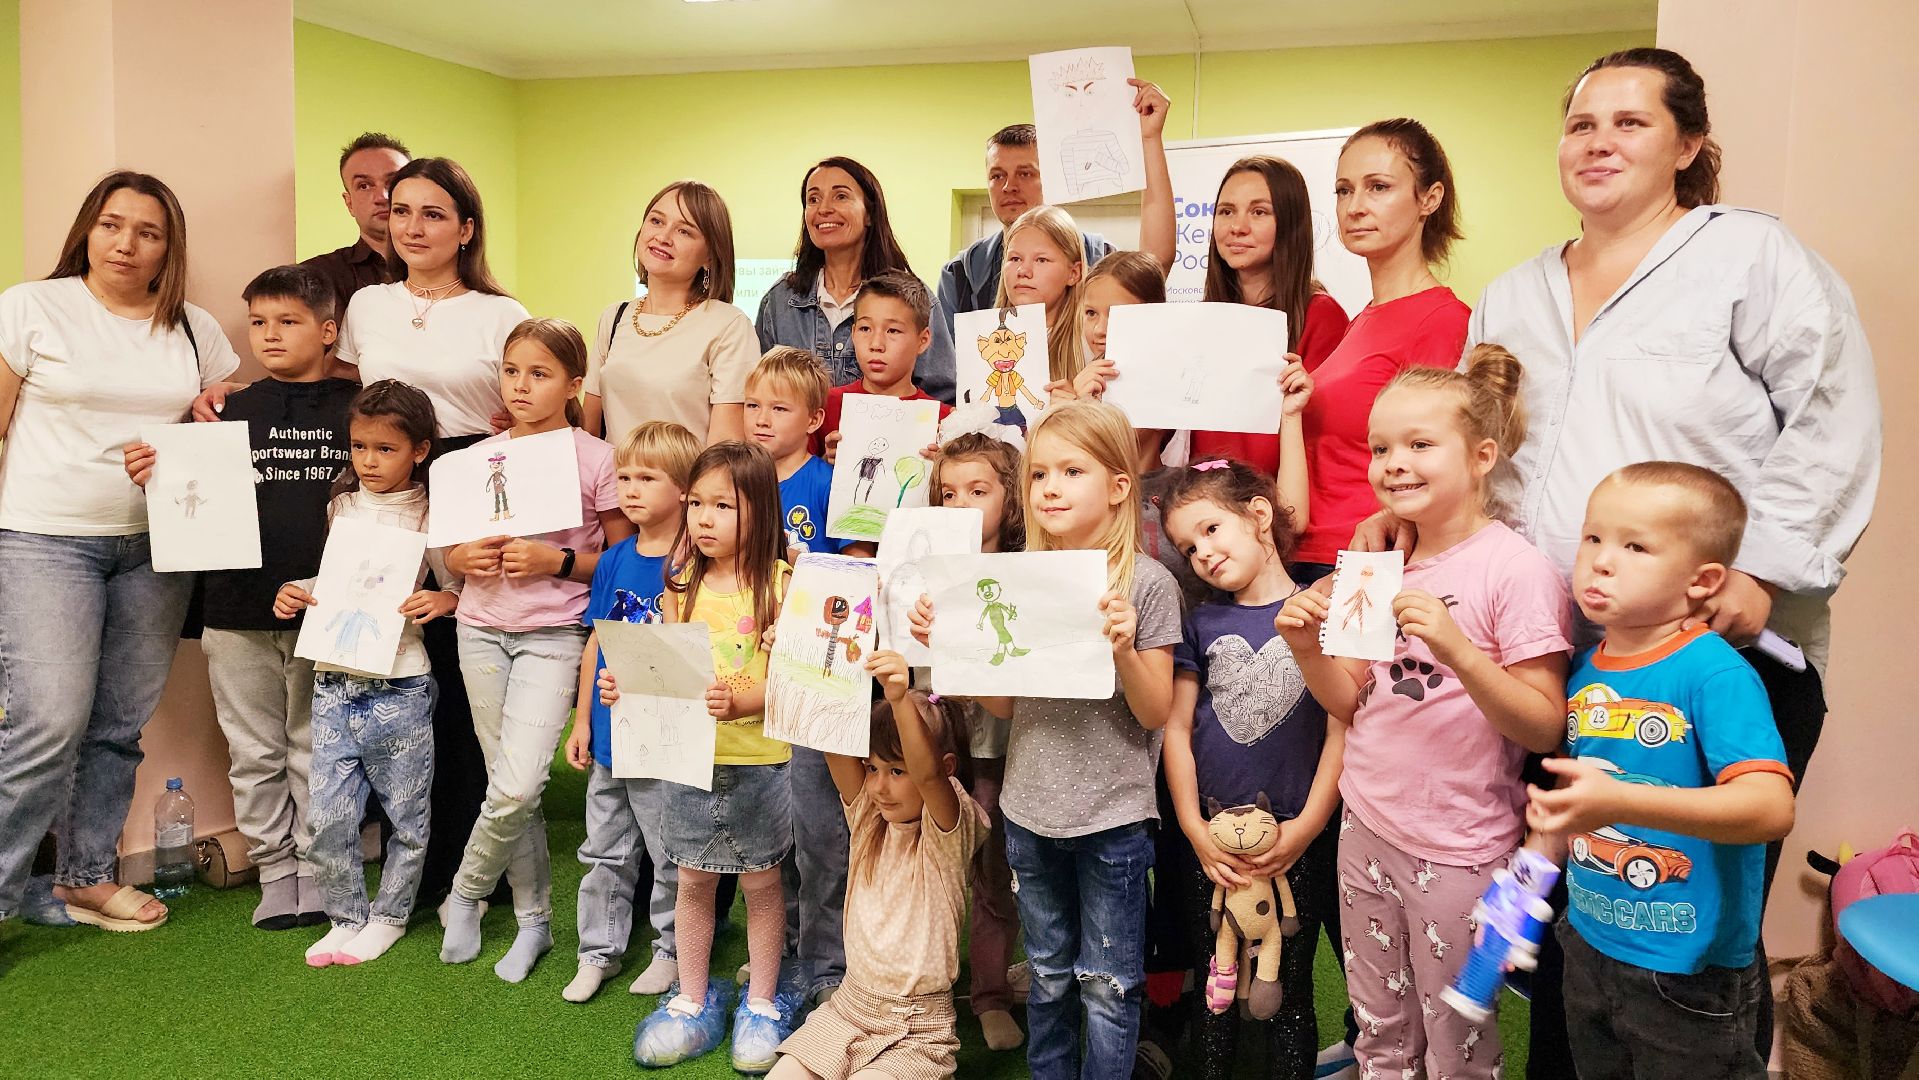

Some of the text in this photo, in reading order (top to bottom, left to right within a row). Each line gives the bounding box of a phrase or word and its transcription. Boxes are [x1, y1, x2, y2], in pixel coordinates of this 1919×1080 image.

[268, 426, 333, 441] Authentic
[265, 466, 334, 480] Since 1967
[1593, 708, 1605, 724] 23
[1613, 898, 1698, 934] CARS
